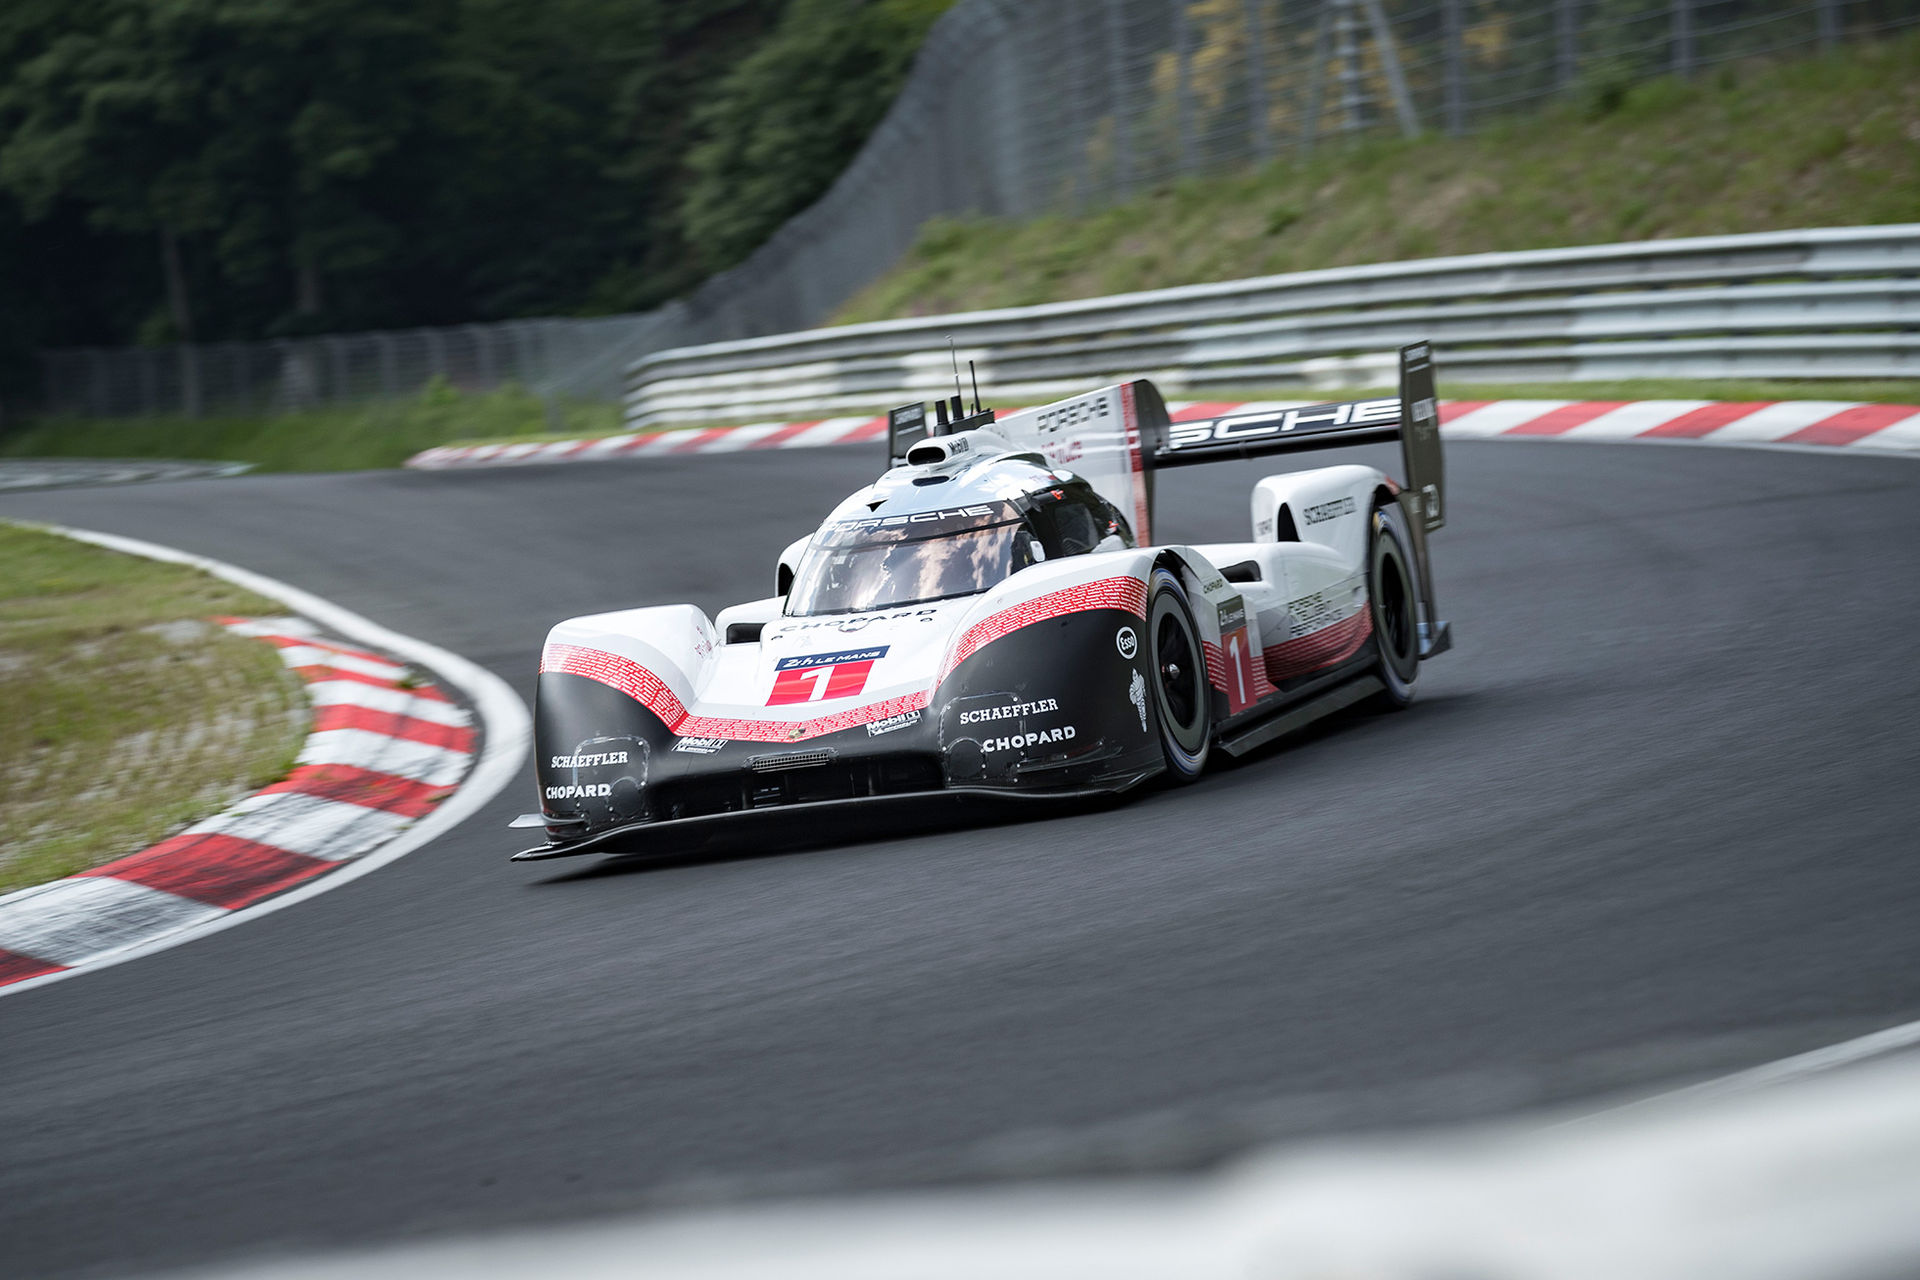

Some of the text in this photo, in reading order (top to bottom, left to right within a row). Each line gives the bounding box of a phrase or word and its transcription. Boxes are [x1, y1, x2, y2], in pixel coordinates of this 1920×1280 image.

[780, 609, 937, 632] CHOPARD
[836, 650, 881, 662] MANS
[1229, 636, 1246, 704] 1
[800, 665, 835, 702] 1
[960, 698, 1059, 725] SCHAEFFLER
[983, 726, 1076, 753] CHOPARD
[551, 751, 629, 768] SCHAEFFLER
[545, 784, 611, 799] CHOPARD
